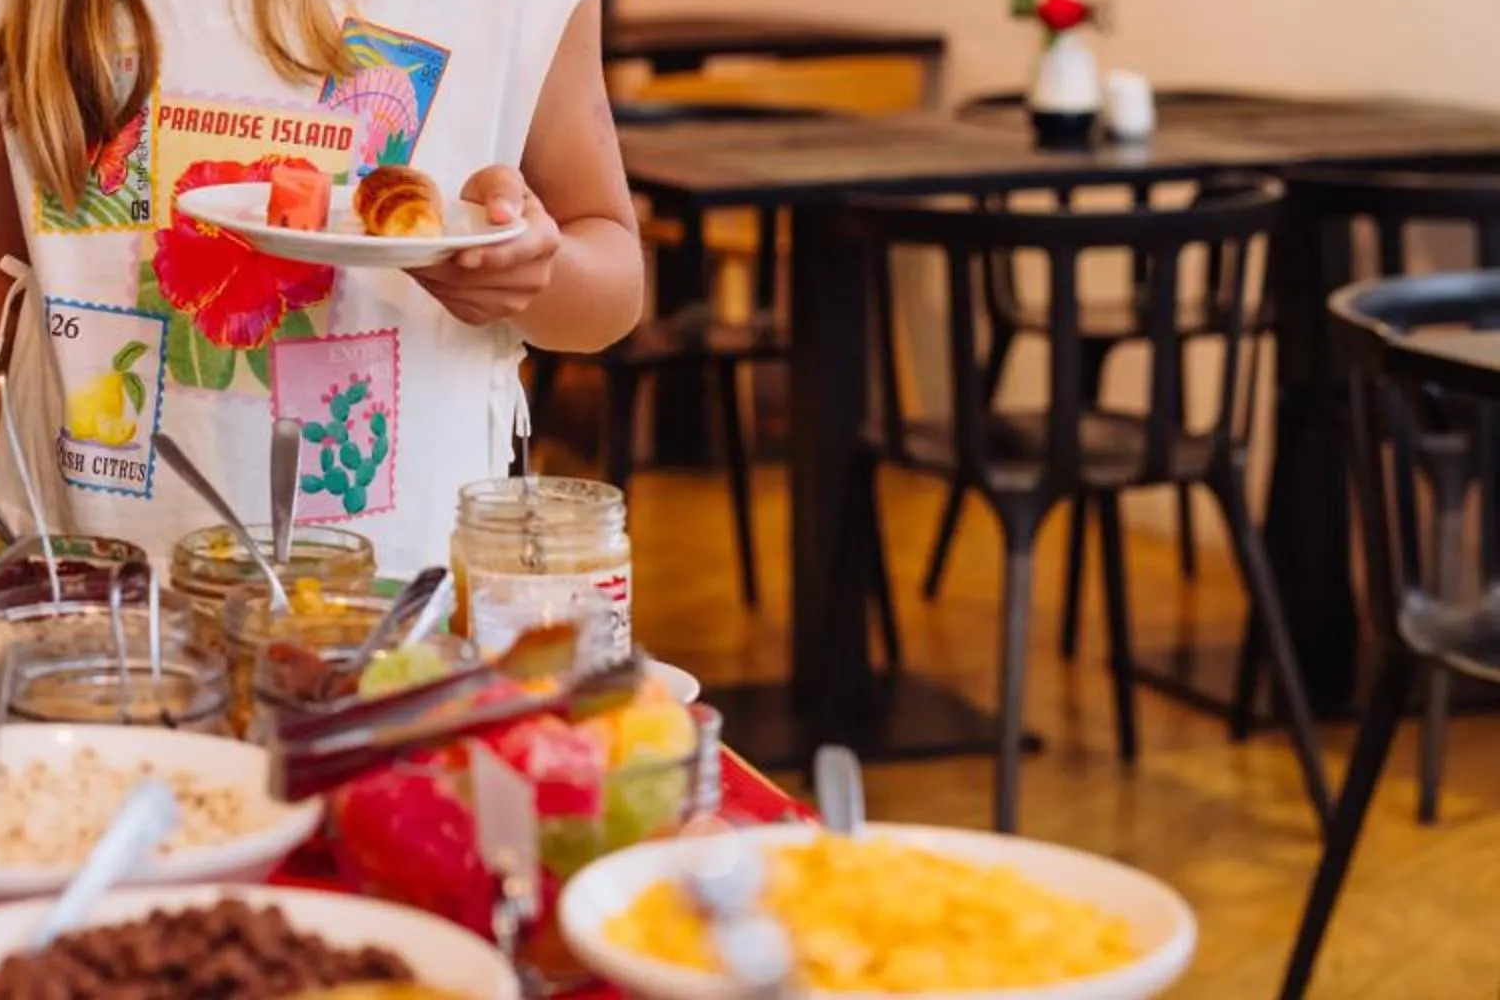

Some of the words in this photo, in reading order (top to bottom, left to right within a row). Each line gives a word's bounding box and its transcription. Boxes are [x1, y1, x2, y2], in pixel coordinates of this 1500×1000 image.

[158, 105, 265, 140] PARADISE
[271, 118, 354, 151] ISLAND
[131, 199, 150, 221] 09
[51, 313, 80, 339] 26
[92, 455, 147, 482] CITRUS
